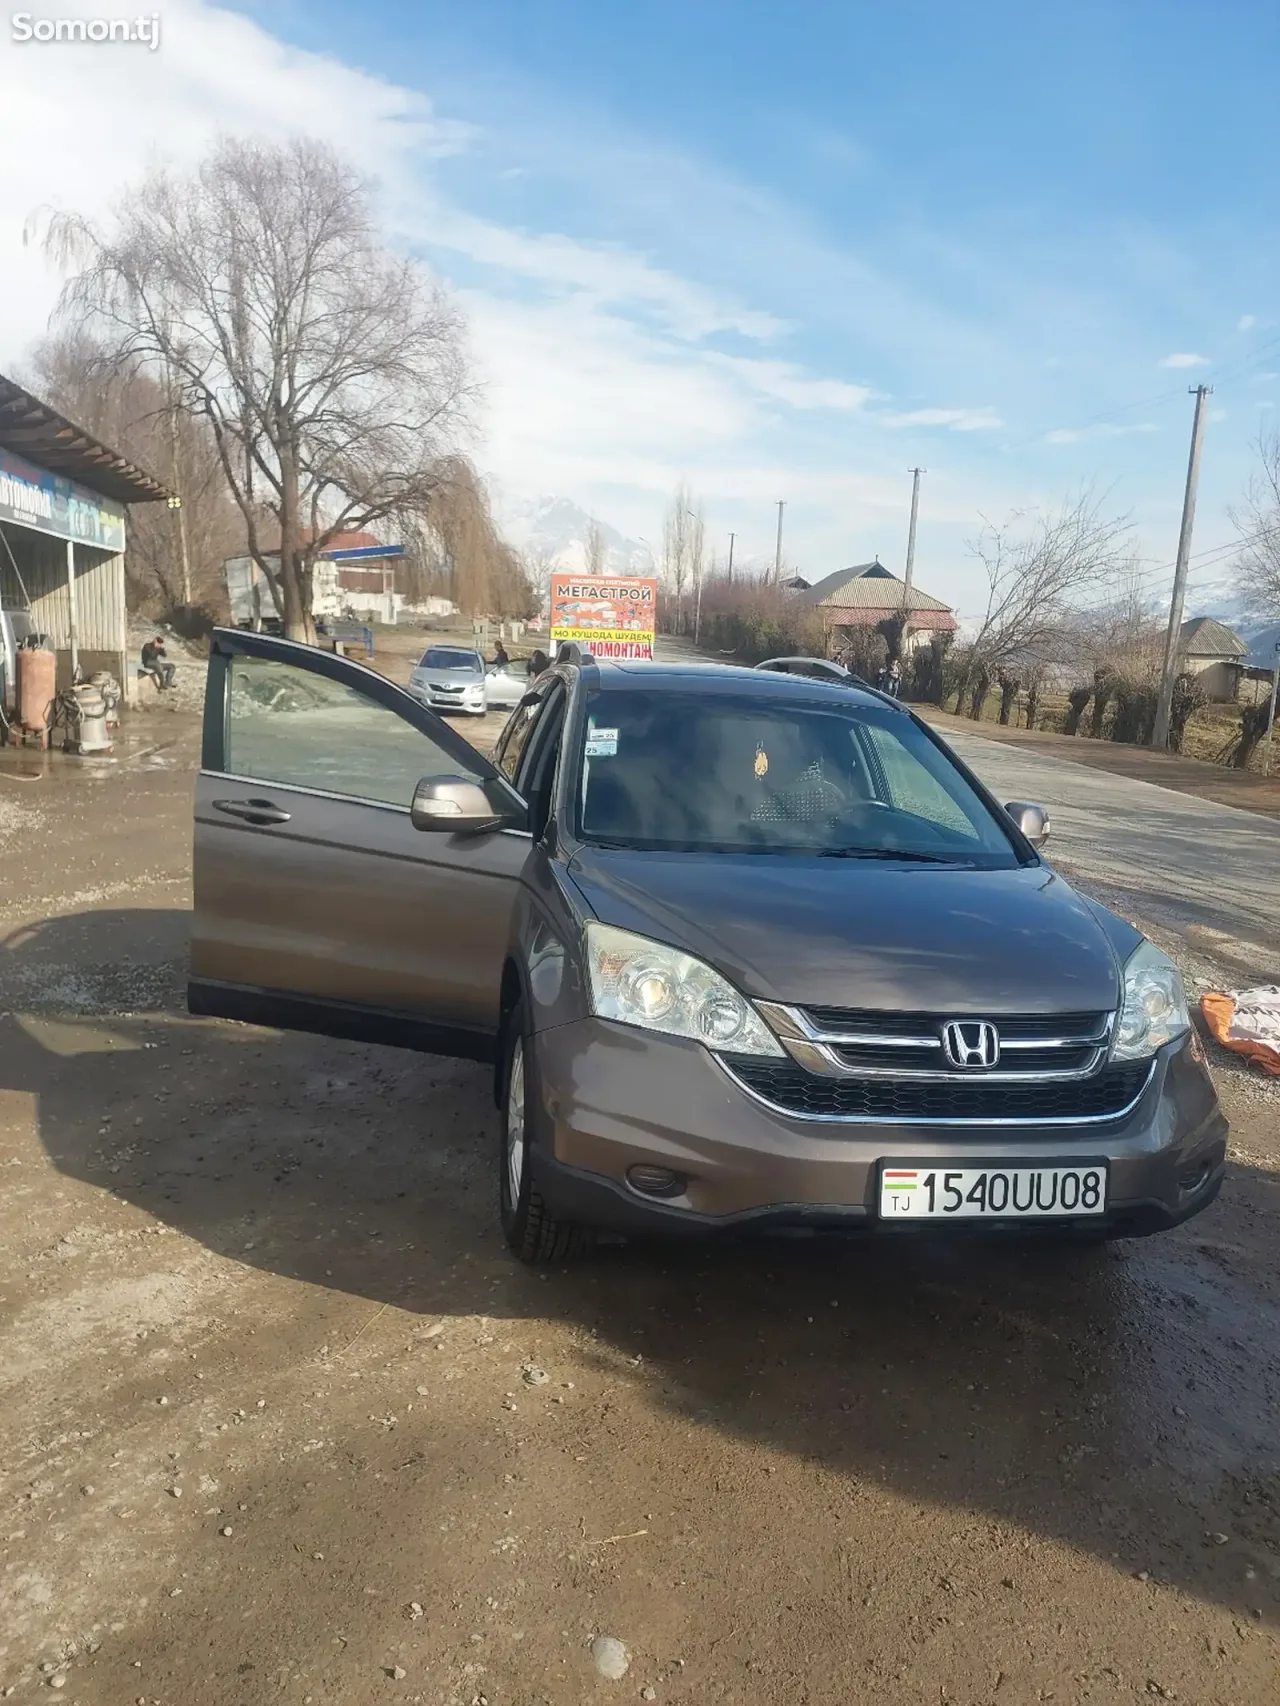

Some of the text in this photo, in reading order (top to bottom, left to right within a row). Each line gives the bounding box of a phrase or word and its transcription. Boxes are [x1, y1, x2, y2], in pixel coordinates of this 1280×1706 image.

[558, 585, 651, 600] МЕГАСТРОЙ
[571, 630, 612, 639] КУШОДА
[587, 641, 652, 659] НОМОНТАЖ
[923, 1171, 1101, 1212] 1540UU08
[891, 1196, 911, 1211] TJ
